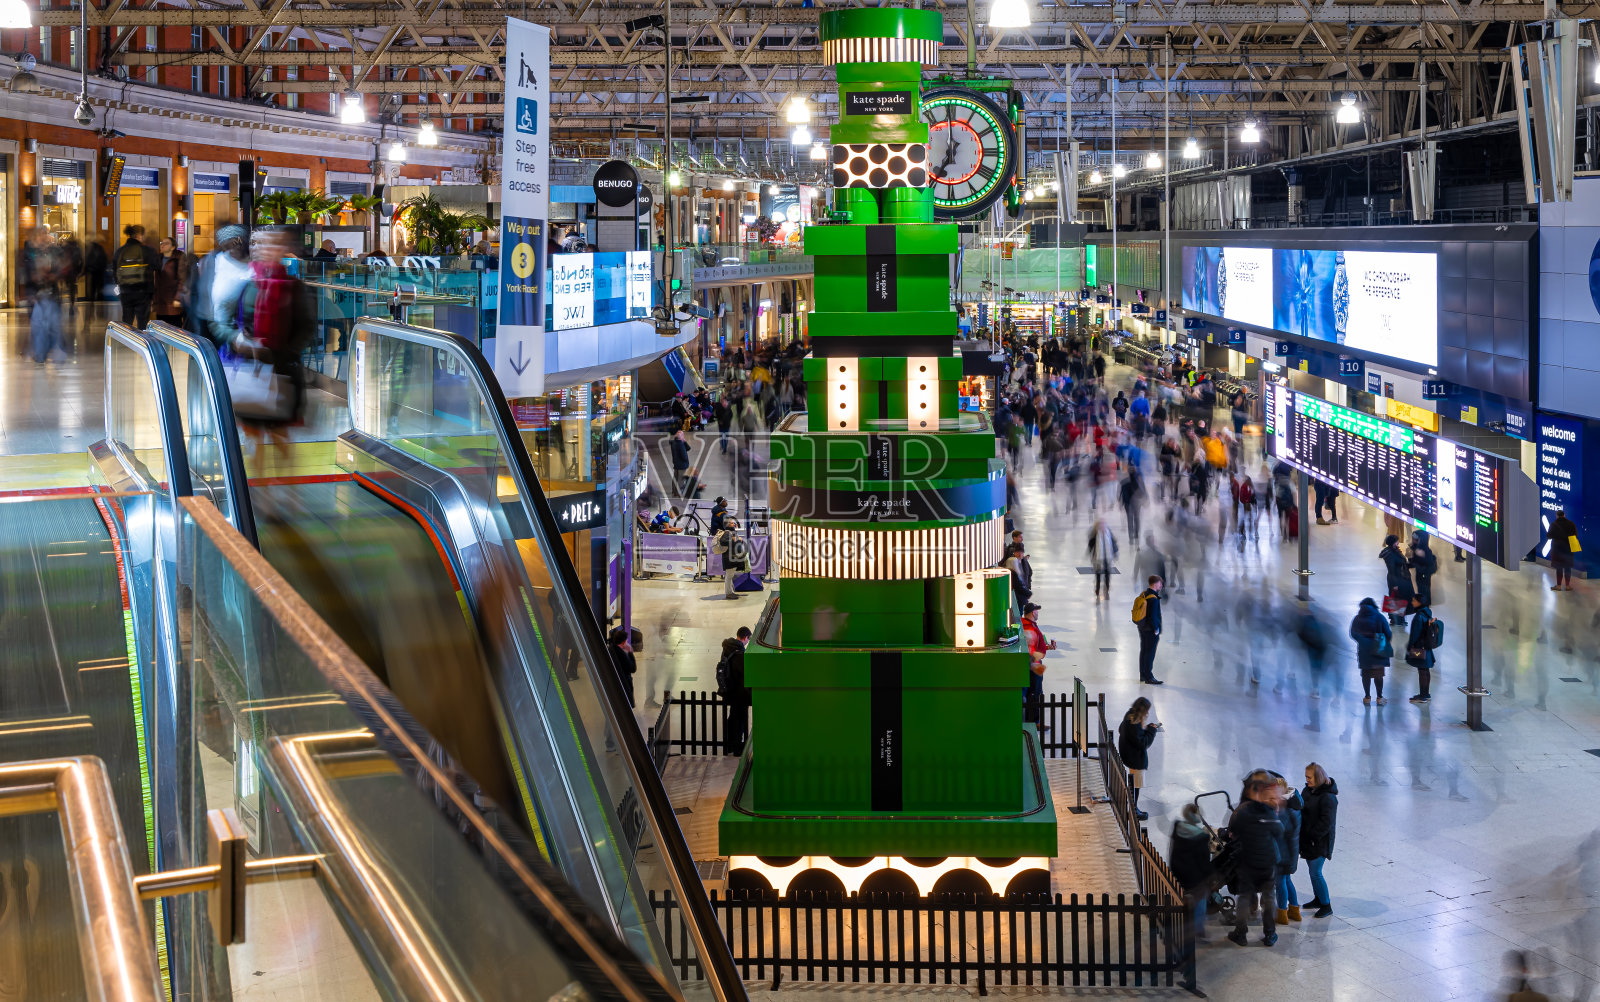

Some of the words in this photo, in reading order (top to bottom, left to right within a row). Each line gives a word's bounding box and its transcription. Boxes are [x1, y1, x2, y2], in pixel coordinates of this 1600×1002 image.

[853, 96, 874, 104] kate
[877, 95, 905, 107] spade
[516, 140, 536, 156] Step
[516, 158, 536, 174] free
[508, 180, 541, 194] access
[598, 180, 632, 188] BENUGO
[507, 222, 526, 238] Way
[527, 223, 540, 236] out
[519, 252, 528, 268] 3
[506, 284, 522, 293] York
[522, 284, 538, 294] Road
[1282, 344, 1288, 353] 9
[1347, 362, 1359, 372] 10
[1431, 384, 1446, 395] 11
[1542, 425, 1576, 442] welcome
[1542, 443, 1566, 455] pharmacy
[1542, 454, 1558, 466] beauty
[1542, 465, 1553, 475] food
[1554, 468, 1557, 476] &
[1558, 469, 1571, 479] drink
[1542, 477, 1553, 488] baby
[1554, 480, 1558, 488] &
[1559, 481, 1570, 491] child
[1542, 489, 1556, 499] photo
[857, 498, 879, 507] kate
[882, 498, 910, 509] spade
[571, 502, 592, 523] PRET
